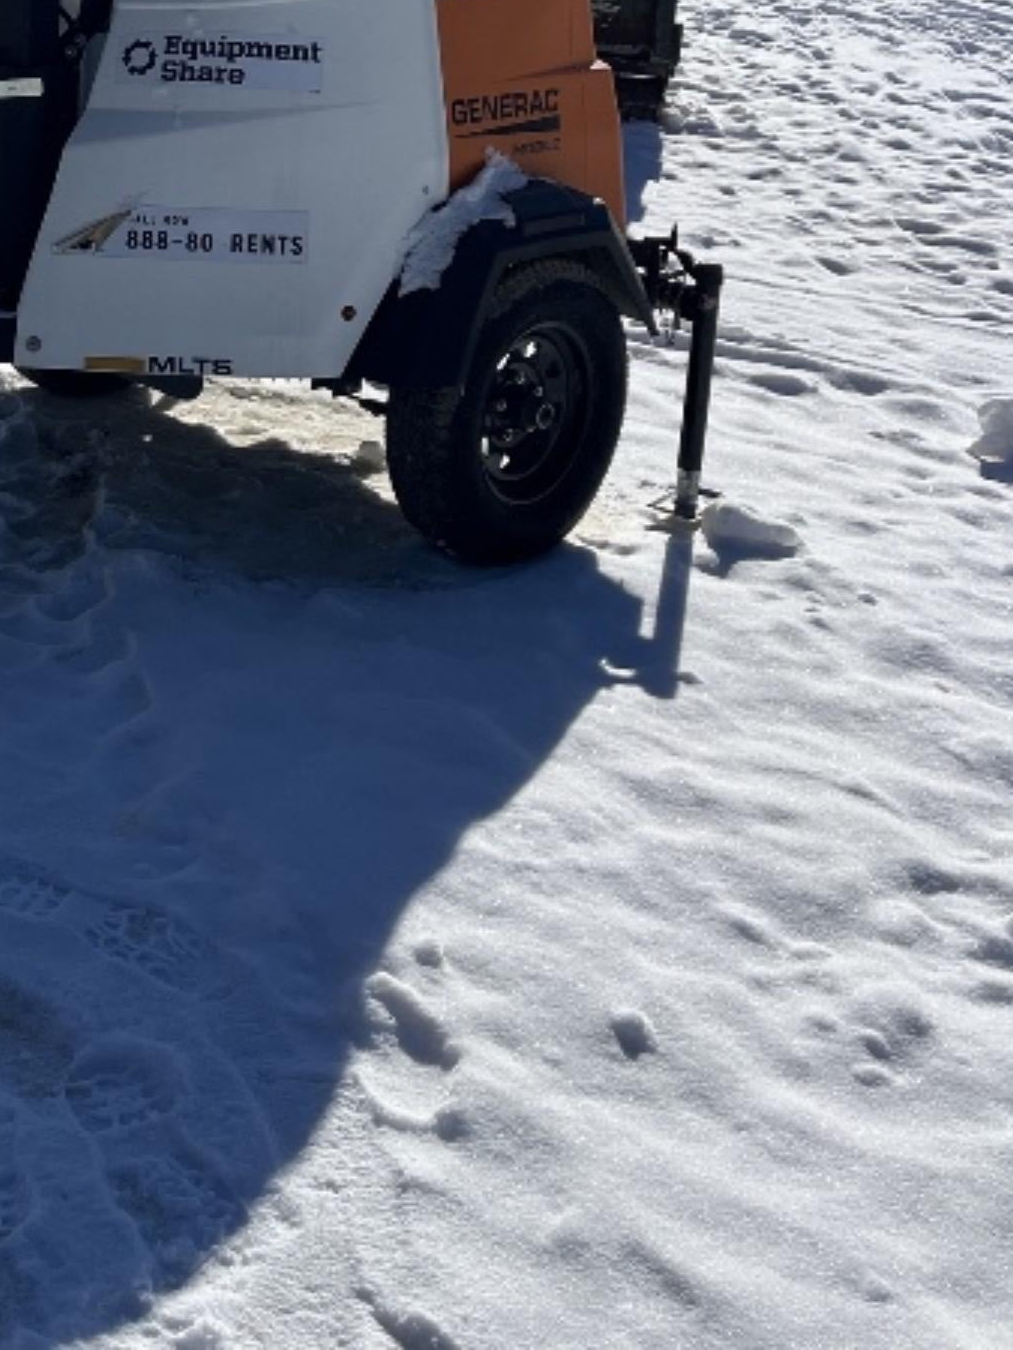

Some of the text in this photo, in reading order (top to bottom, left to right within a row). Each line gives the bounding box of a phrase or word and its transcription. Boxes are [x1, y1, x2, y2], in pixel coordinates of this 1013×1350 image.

[163, 35, 322, 63] Equipment
[160, 59, 245, 85] Share
[451, 87, 560, 125] GENERAC
[126, 229, 304, 256] 888-80 RENTS
